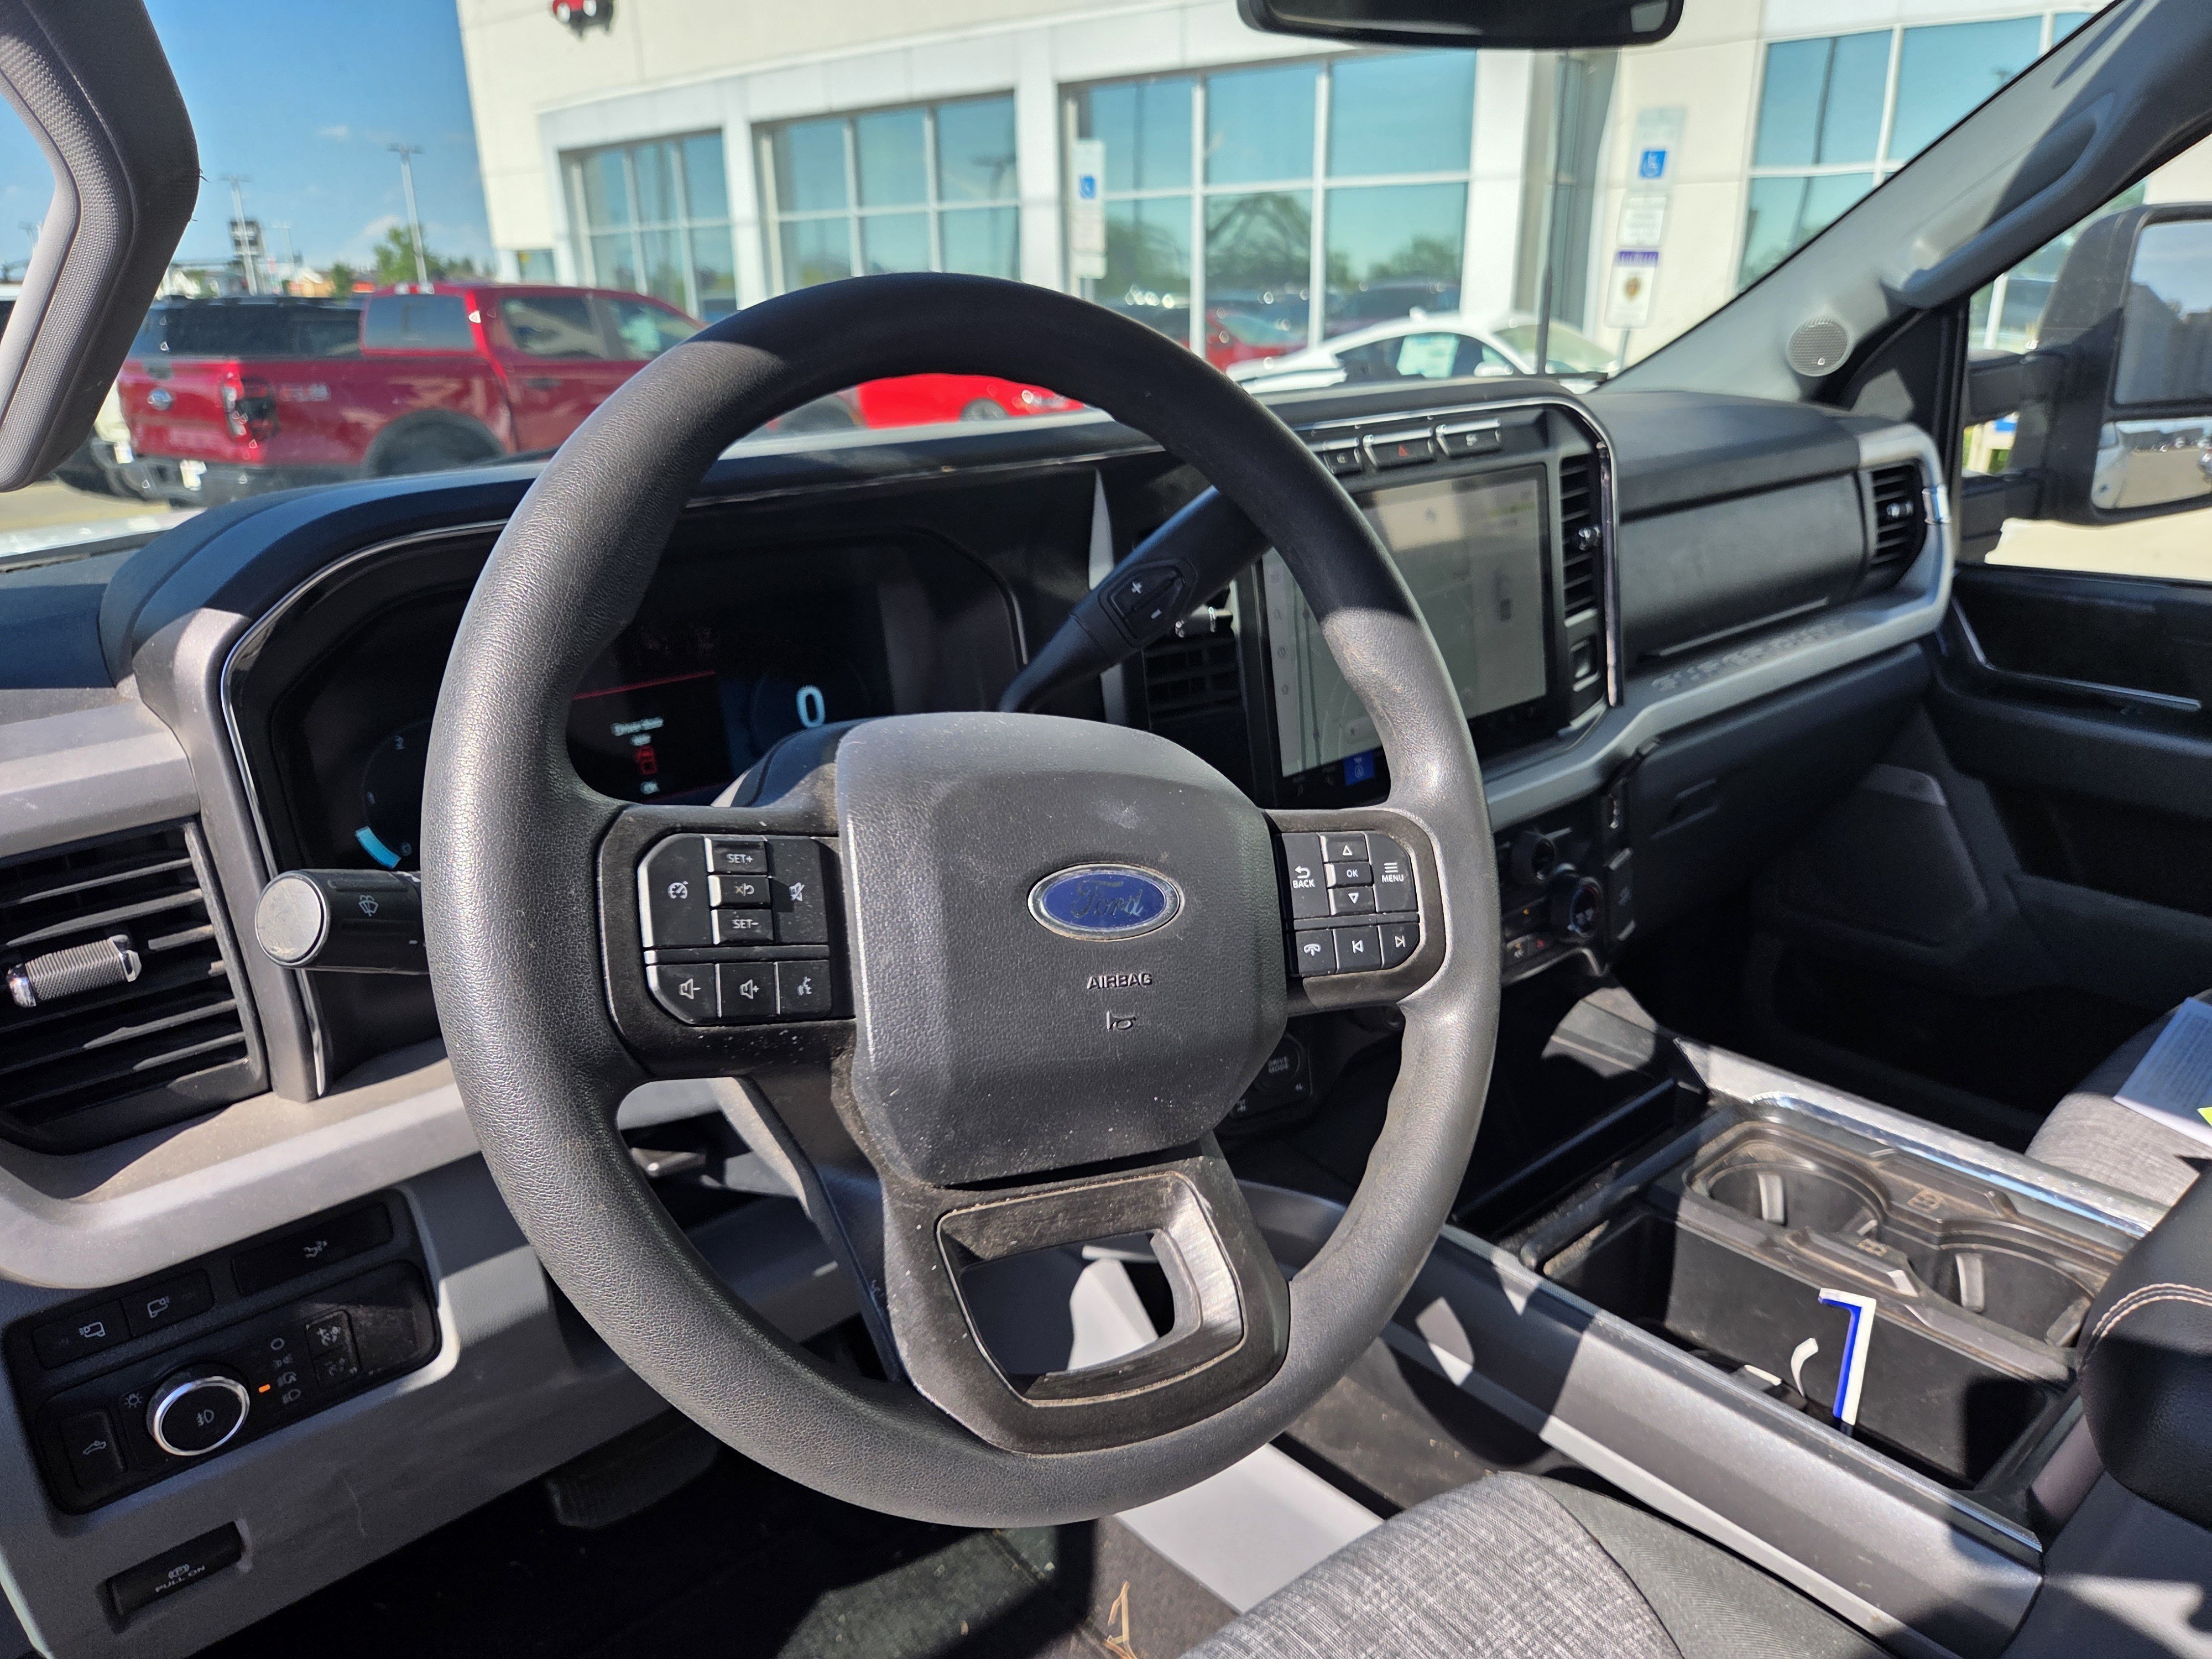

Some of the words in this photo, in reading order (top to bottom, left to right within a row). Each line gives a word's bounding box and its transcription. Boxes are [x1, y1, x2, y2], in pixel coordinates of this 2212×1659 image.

[796, 685, 825, 729] 0
[726, 853, 754, 864] SET+
[1346, 869, 1359, 878] OK
[1381, 874, 1405, 883] MENU
[1292, 879, 1316, 889] BACK
[1069, 879, 1145, 920] Ford
[1086, 972, 1153, 990] AIRBAG
